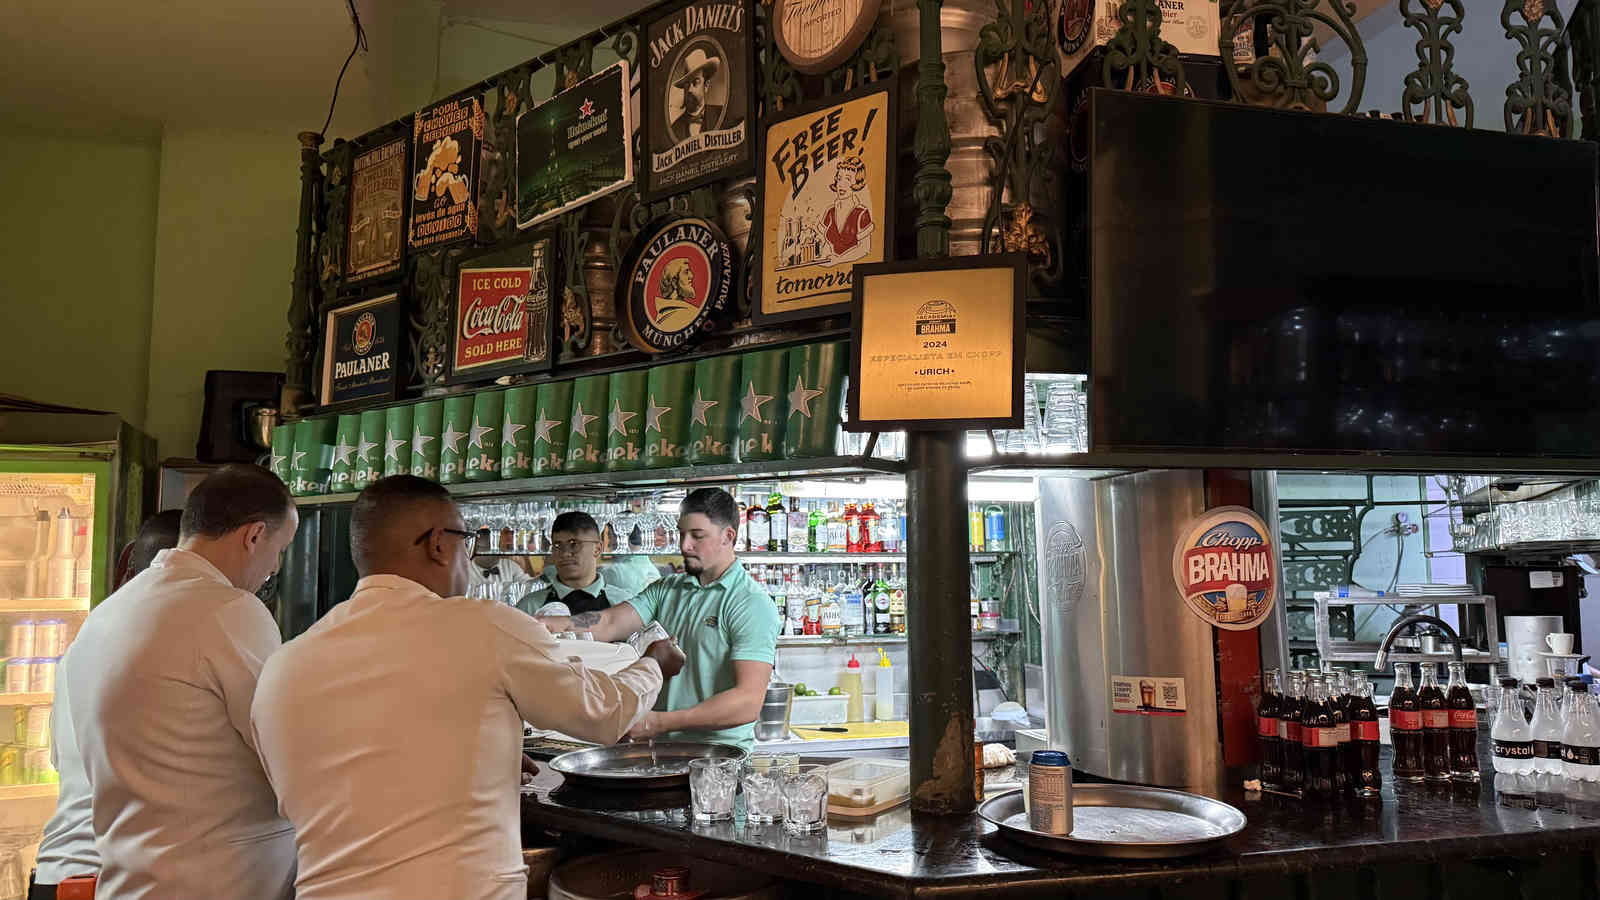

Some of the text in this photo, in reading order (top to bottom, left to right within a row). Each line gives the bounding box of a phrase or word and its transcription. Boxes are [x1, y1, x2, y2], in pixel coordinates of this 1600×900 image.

[649, 20, 684, 68] JACK
[656, 130, 744, 170] JACK DANIEL DISTILLER
[771, 107, 843, 184] FREE
[635, 227, 720, 285] PAULANER
[472, 276, 522, 291] ICE COLD
[715, 242, 731, 312] PAULANER
[921, 324, 952, 335] BRAHMA
[465, 338, 522, 359] SOLD HERE
[923, 341, 948, 349] 2024
[335, 352, 391, 379] PAULANER
[1202, 532, 1261, 550] Chopp
[1189, 552, 1270, 586] BRAHMA
[1496, 745, 1530, 758] crystal
